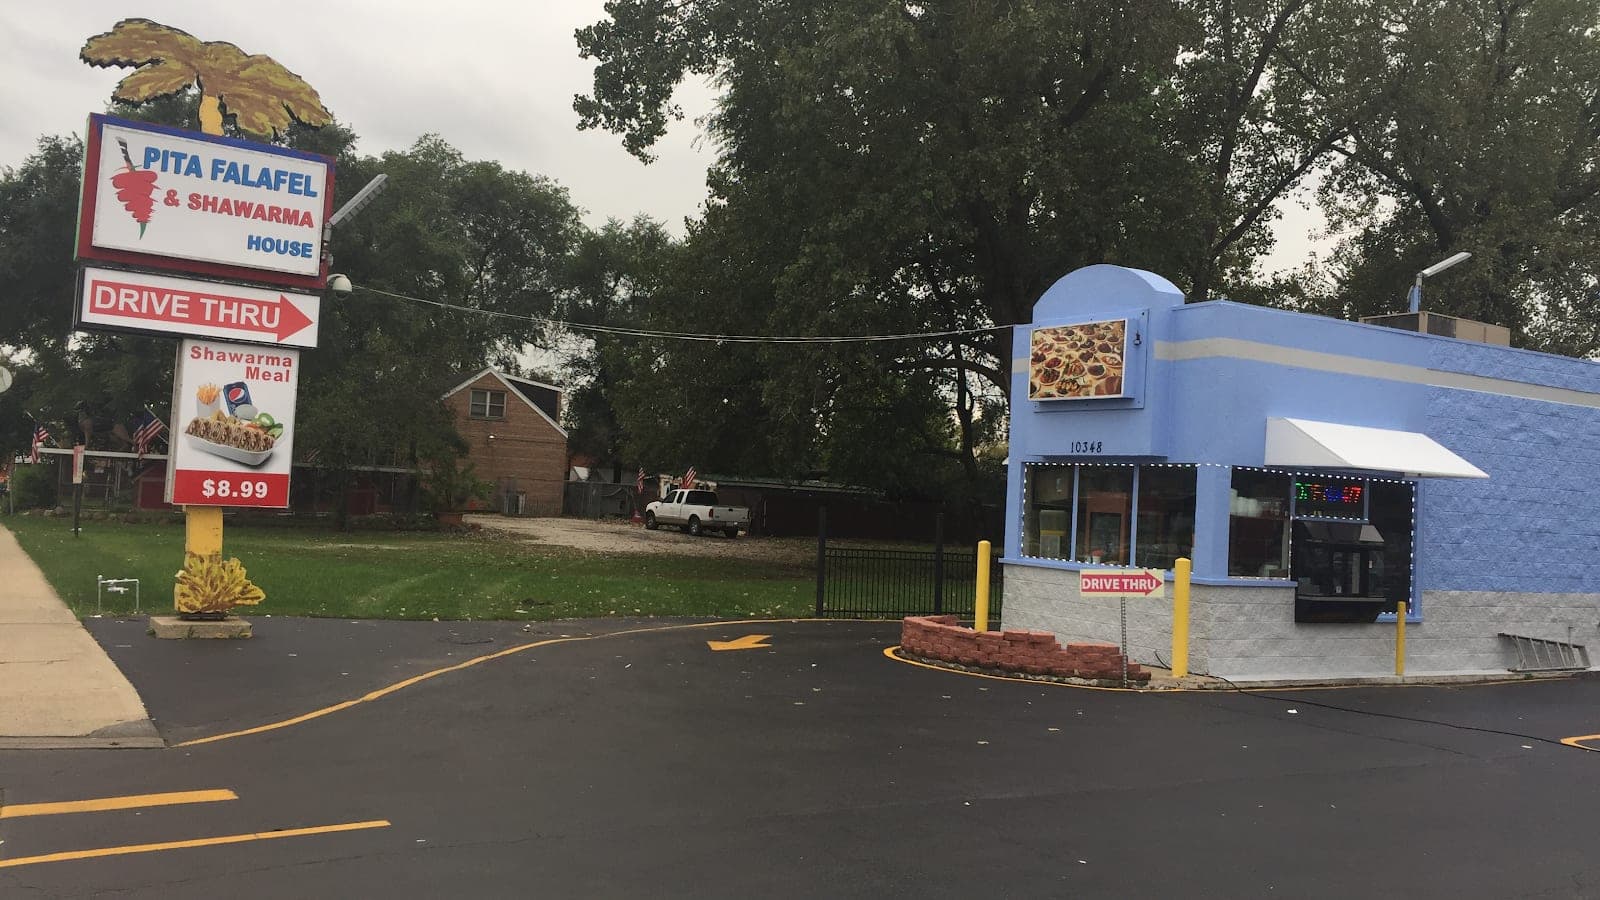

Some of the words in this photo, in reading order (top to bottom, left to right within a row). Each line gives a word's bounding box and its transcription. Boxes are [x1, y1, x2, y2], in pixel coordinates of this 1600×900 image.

[143, 146, 203, 179] PITA
[210, 158, 318, 198] FALAFEL
[163, 189, 180, 207] &
[188, 192, 314, 228] SHAWARMA
[247, 235, 313, 258] HOUSE
[94, 285, 190, 318] DRIVE
[200, 298, 281, 328] THRU
[190, 345, 293, 368] Shawarma
[245, 366, 290, 383] Meal
[1071, 441, 1102, 453] 10348
[202, 478, 268, 498] $8.99
[1082, 578, 1120, 590] DRIVE
[1121, 578, 1157, 590] THRU
